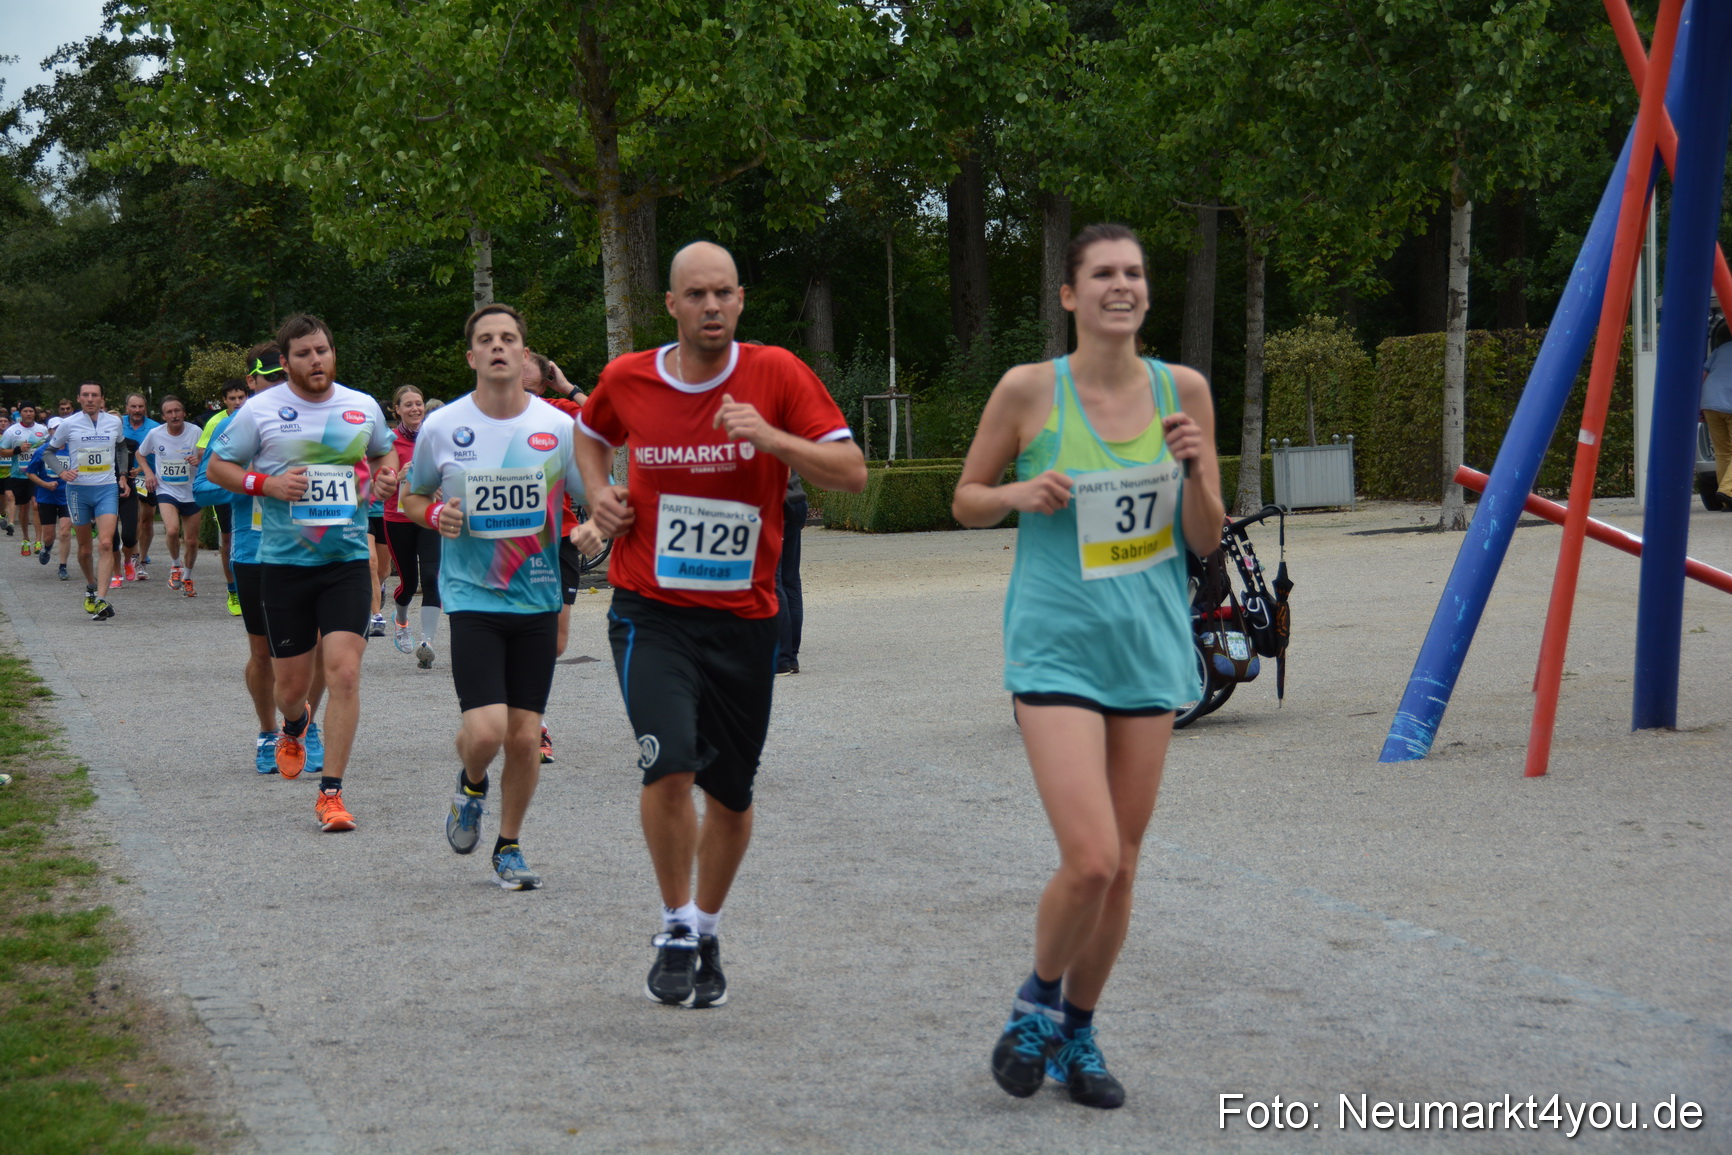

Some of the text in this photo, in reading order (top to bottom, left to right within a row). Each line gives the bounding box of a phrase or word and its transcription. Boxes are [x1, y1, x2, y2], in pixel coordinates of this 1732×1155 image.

[88, 453, 102, 465] 80
[635, 443, 735, 464] NEUMARKT
[163, 465, 187, 476] 2674
[467, 473, 534, 483] PARTL Neumarkt
[1078, 473, 1170, 495] PARTL Neumarkt
[475, 484, 540, 512] 2505
[309, 508, 342, 518] Markus
[661, 503, 745, 521] PARTL Neumarkt
[1115, 490, 1158, 534] 37
[485, 517, 532, 529] Christian
[667, 519, 750, 556] 2129
[529, 556, 548, 568] 16.
[678, 562, 731, 578] Andreas
